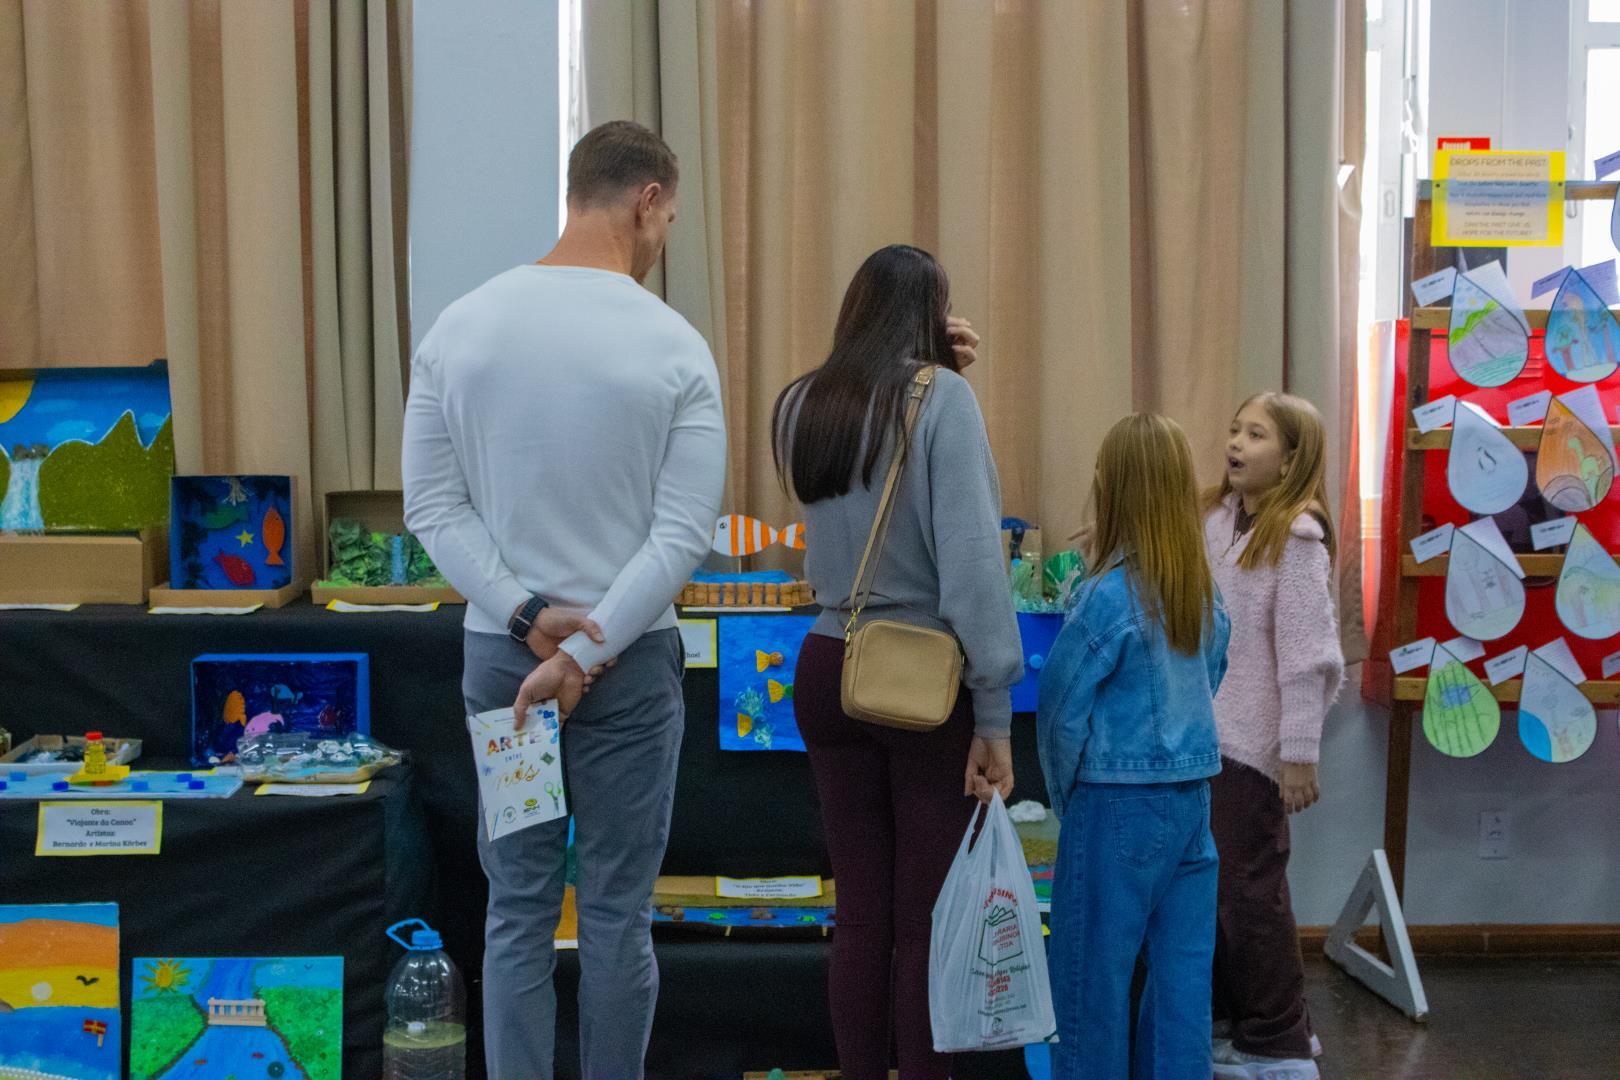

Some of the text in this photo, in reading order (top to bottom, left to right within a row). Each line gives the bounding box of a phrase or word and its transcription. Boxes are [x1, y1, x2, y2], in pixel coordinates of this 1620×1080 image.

[1449, 157, 1546, 167] DROPS FROM THE PAST
[486, 731, 541, 757] ARTE
